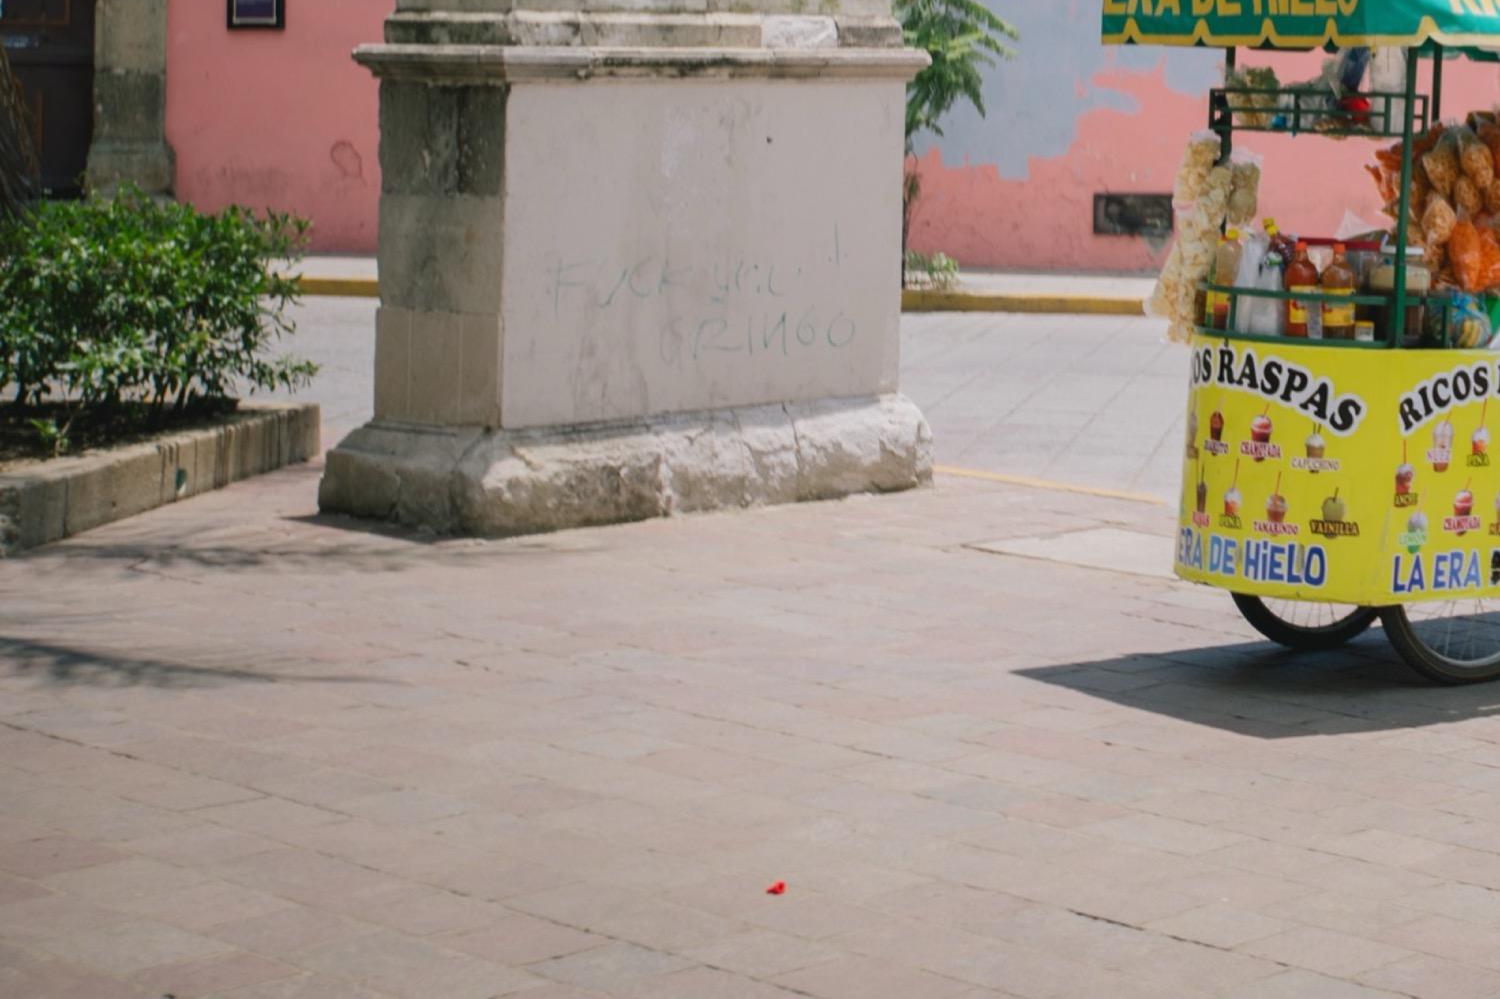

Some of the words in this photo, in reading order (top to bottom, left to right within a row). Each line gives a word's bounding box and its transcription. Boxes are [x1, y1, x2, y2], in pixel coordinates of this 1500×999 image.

[1191, 347, 1213, 384] OS
[1217, 348, 1362, 432] RASPAS
[1399, 365, 1489, 431] RICOS
[1210, 534, 1237, 575] DE
[1392, 555, 1425, 593] LA
[1433, 550, 1481, 589] ERA
